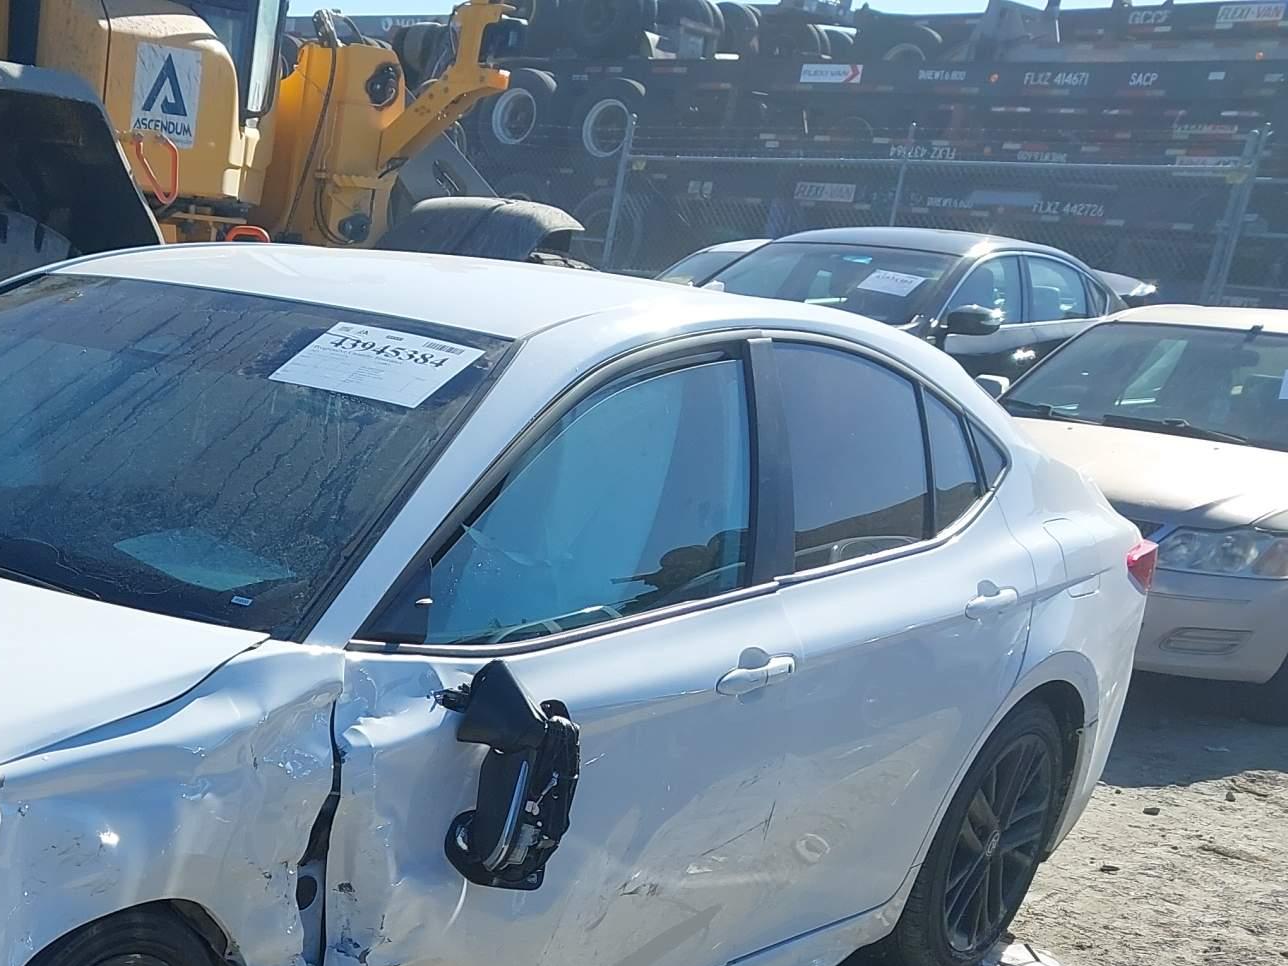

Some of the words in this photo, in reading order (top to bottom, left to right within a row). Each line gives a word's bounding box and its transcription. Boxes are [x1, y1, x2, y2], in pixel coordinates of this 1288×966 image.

[1023, 72, 1052, 86] FLXZ
[1053, 72, 1089, 87] 414671
[1128, 72, 1159, 86] SACP
[133, 117, 192, 137] ASCENDUM
[329, 336, 451, 368] 43945384
